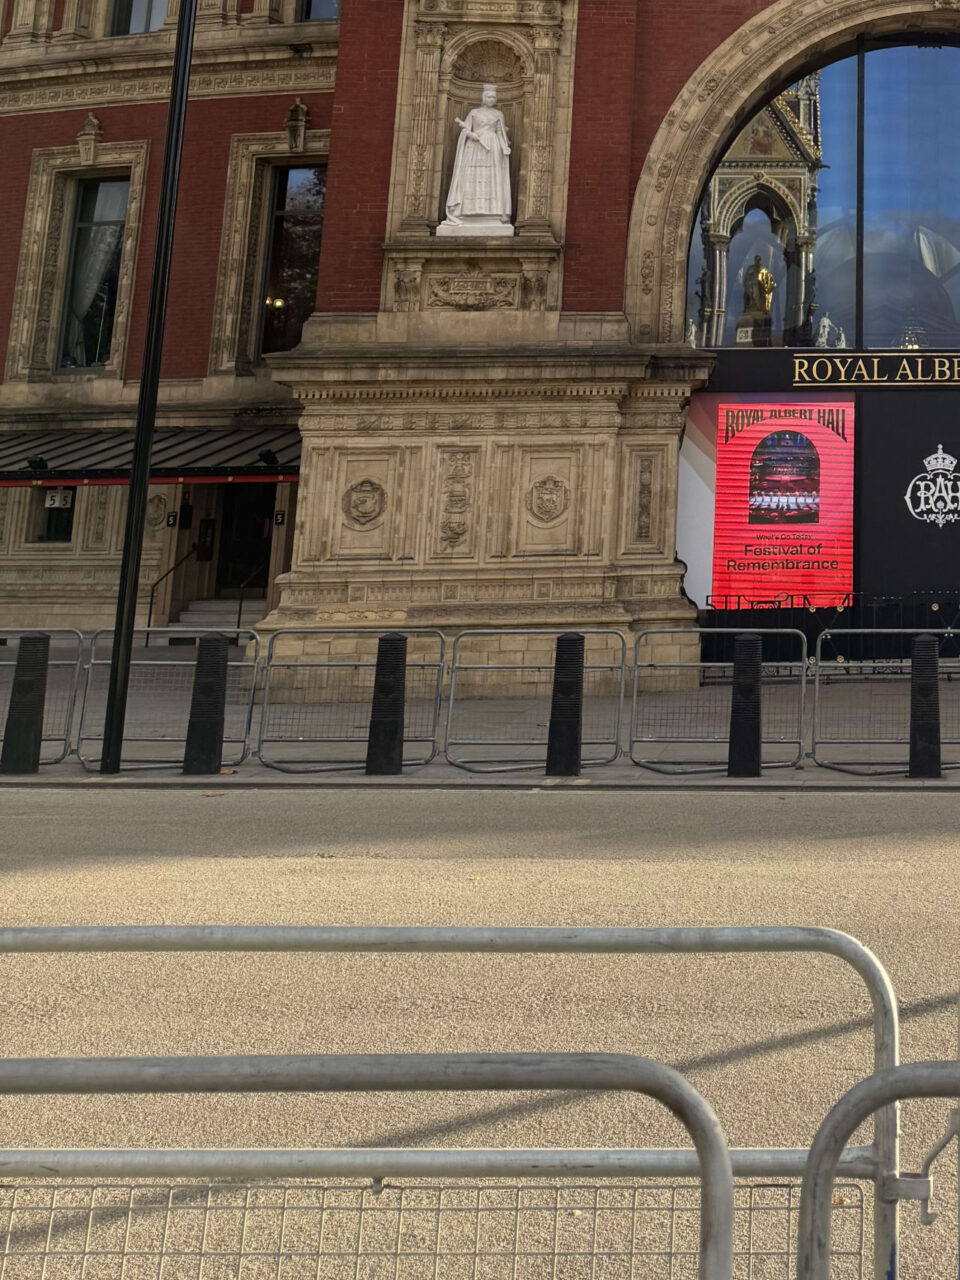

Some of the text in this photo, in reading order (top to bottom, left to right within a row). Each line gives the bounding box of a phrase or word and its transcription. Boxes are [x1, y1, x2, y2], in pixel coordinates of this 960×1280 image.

[792, 358, 888, 381] ROYAL
[724, 408, 848, 445] ROYAL ALBERT HALL
[49, 495, 57, 506] 5
[62, 495, 69, 506] 5
[744, 543, 823, 556] Festival of
[726, 559, 839, 571] Remembrance
